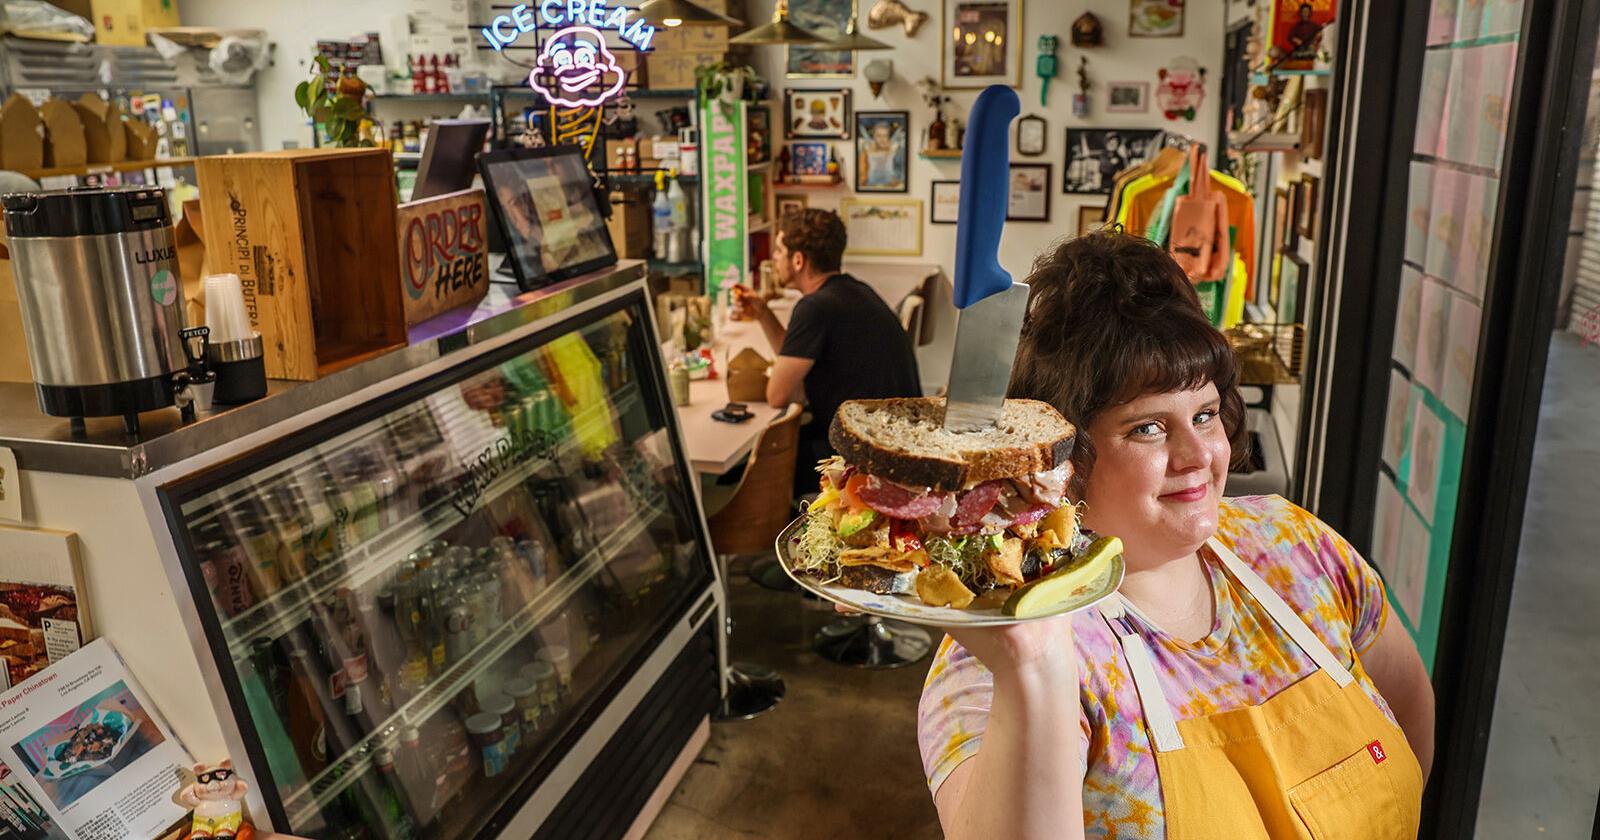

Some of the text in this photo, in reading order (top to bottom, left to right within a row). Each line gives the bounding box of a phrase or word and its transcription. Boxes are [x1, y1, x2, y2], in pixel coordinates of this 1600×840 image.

[482, 0, 655, 51] ICE CREAM
[233, 208, 250, 262] PRINCIPI
[404, 203, 483, 298] ORDER
[434, 253, 483, 300] HERE
[184, 328, 208, 338] FETCO
[1, 692, 23, 708] Paper
[22, 672, 58, 695] Chinatown
[1372, 746, 1384, 760] &
